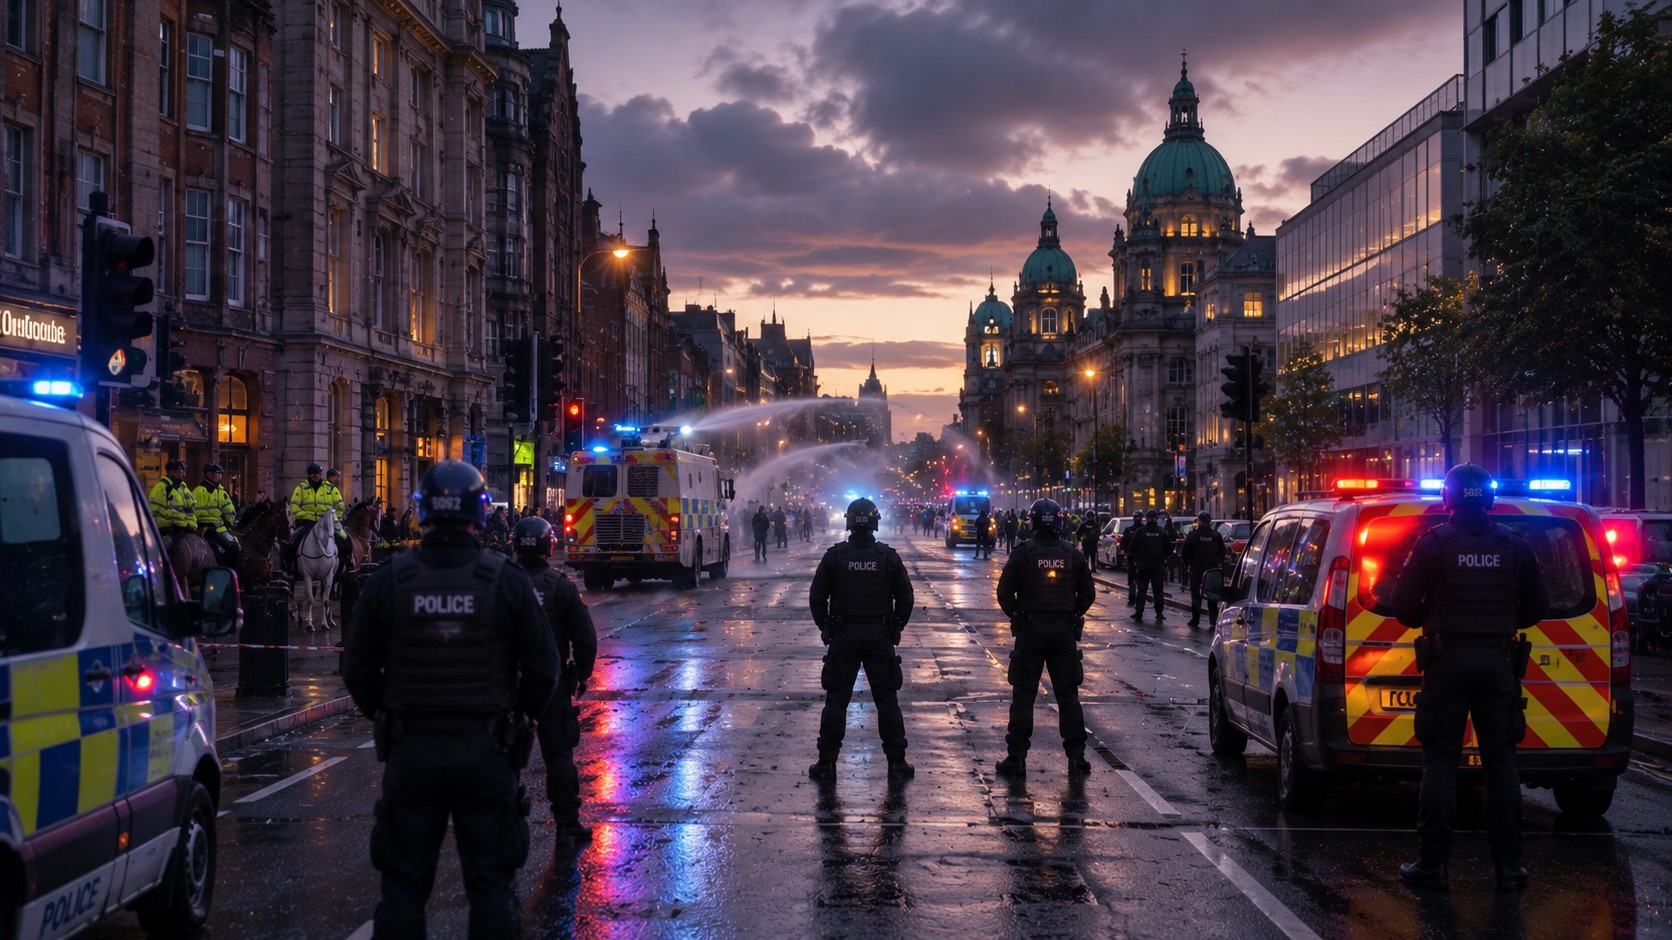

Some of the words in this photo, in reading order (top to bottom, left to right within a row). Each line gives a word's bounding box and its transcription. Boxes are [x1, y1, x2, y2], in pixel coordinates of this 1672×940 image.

[848, 561, 877, 571] POLICE
[1038, 559, 1065, 569] POLICE
[1458, 554, 1501, 568] POLICE
[413, 595, 475, 614] POLICE
[38, 876, 102, 939] POLICE
